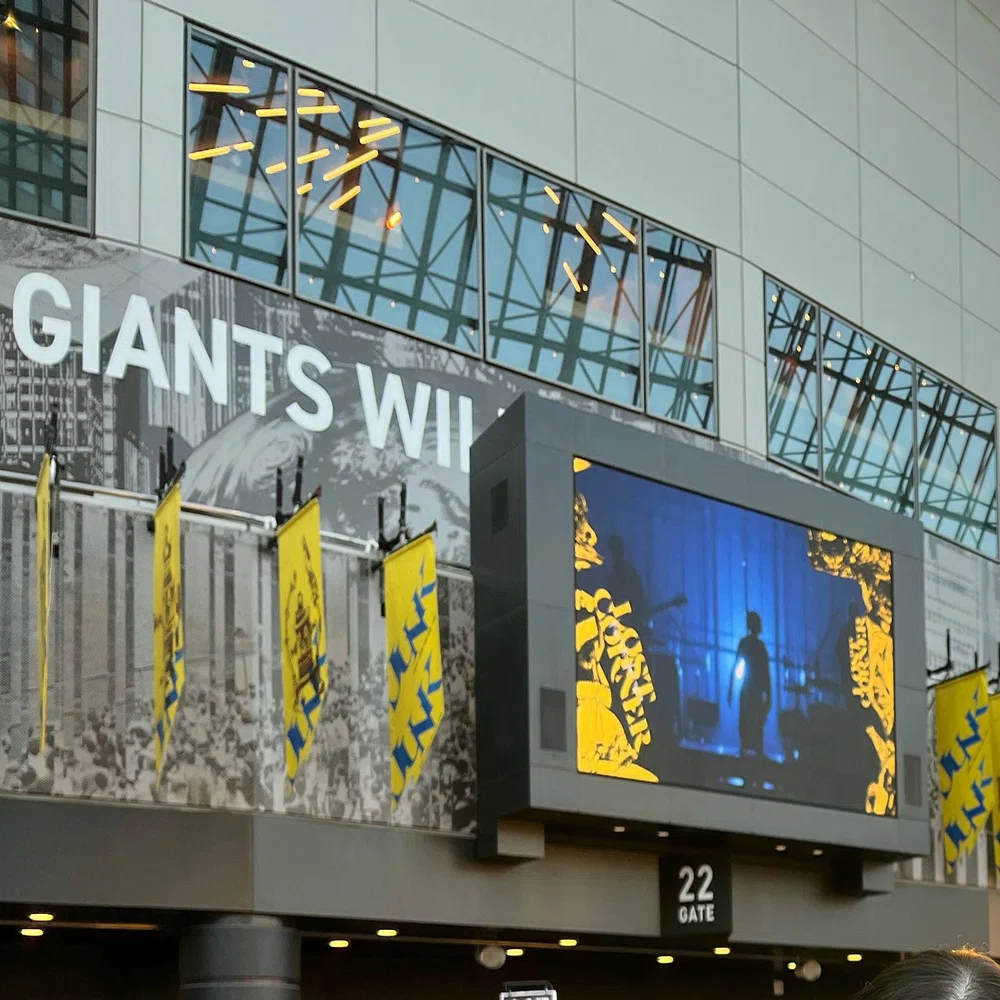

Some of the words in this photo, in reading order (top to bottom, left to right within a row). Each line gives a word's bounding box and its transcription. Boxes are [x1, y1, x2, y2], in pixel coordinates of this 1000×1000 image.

[12, 271, 334, 433] GIANTS
[389, 553, 437, 711] JUNK
[392, 650, 442, 804] JUNK
[940, 684, 989, 799] JUNK
[945, 757, 993, 868] JUNK
[678, 904, 715, 924] GATE
[679, 863, 714, 903] 22
